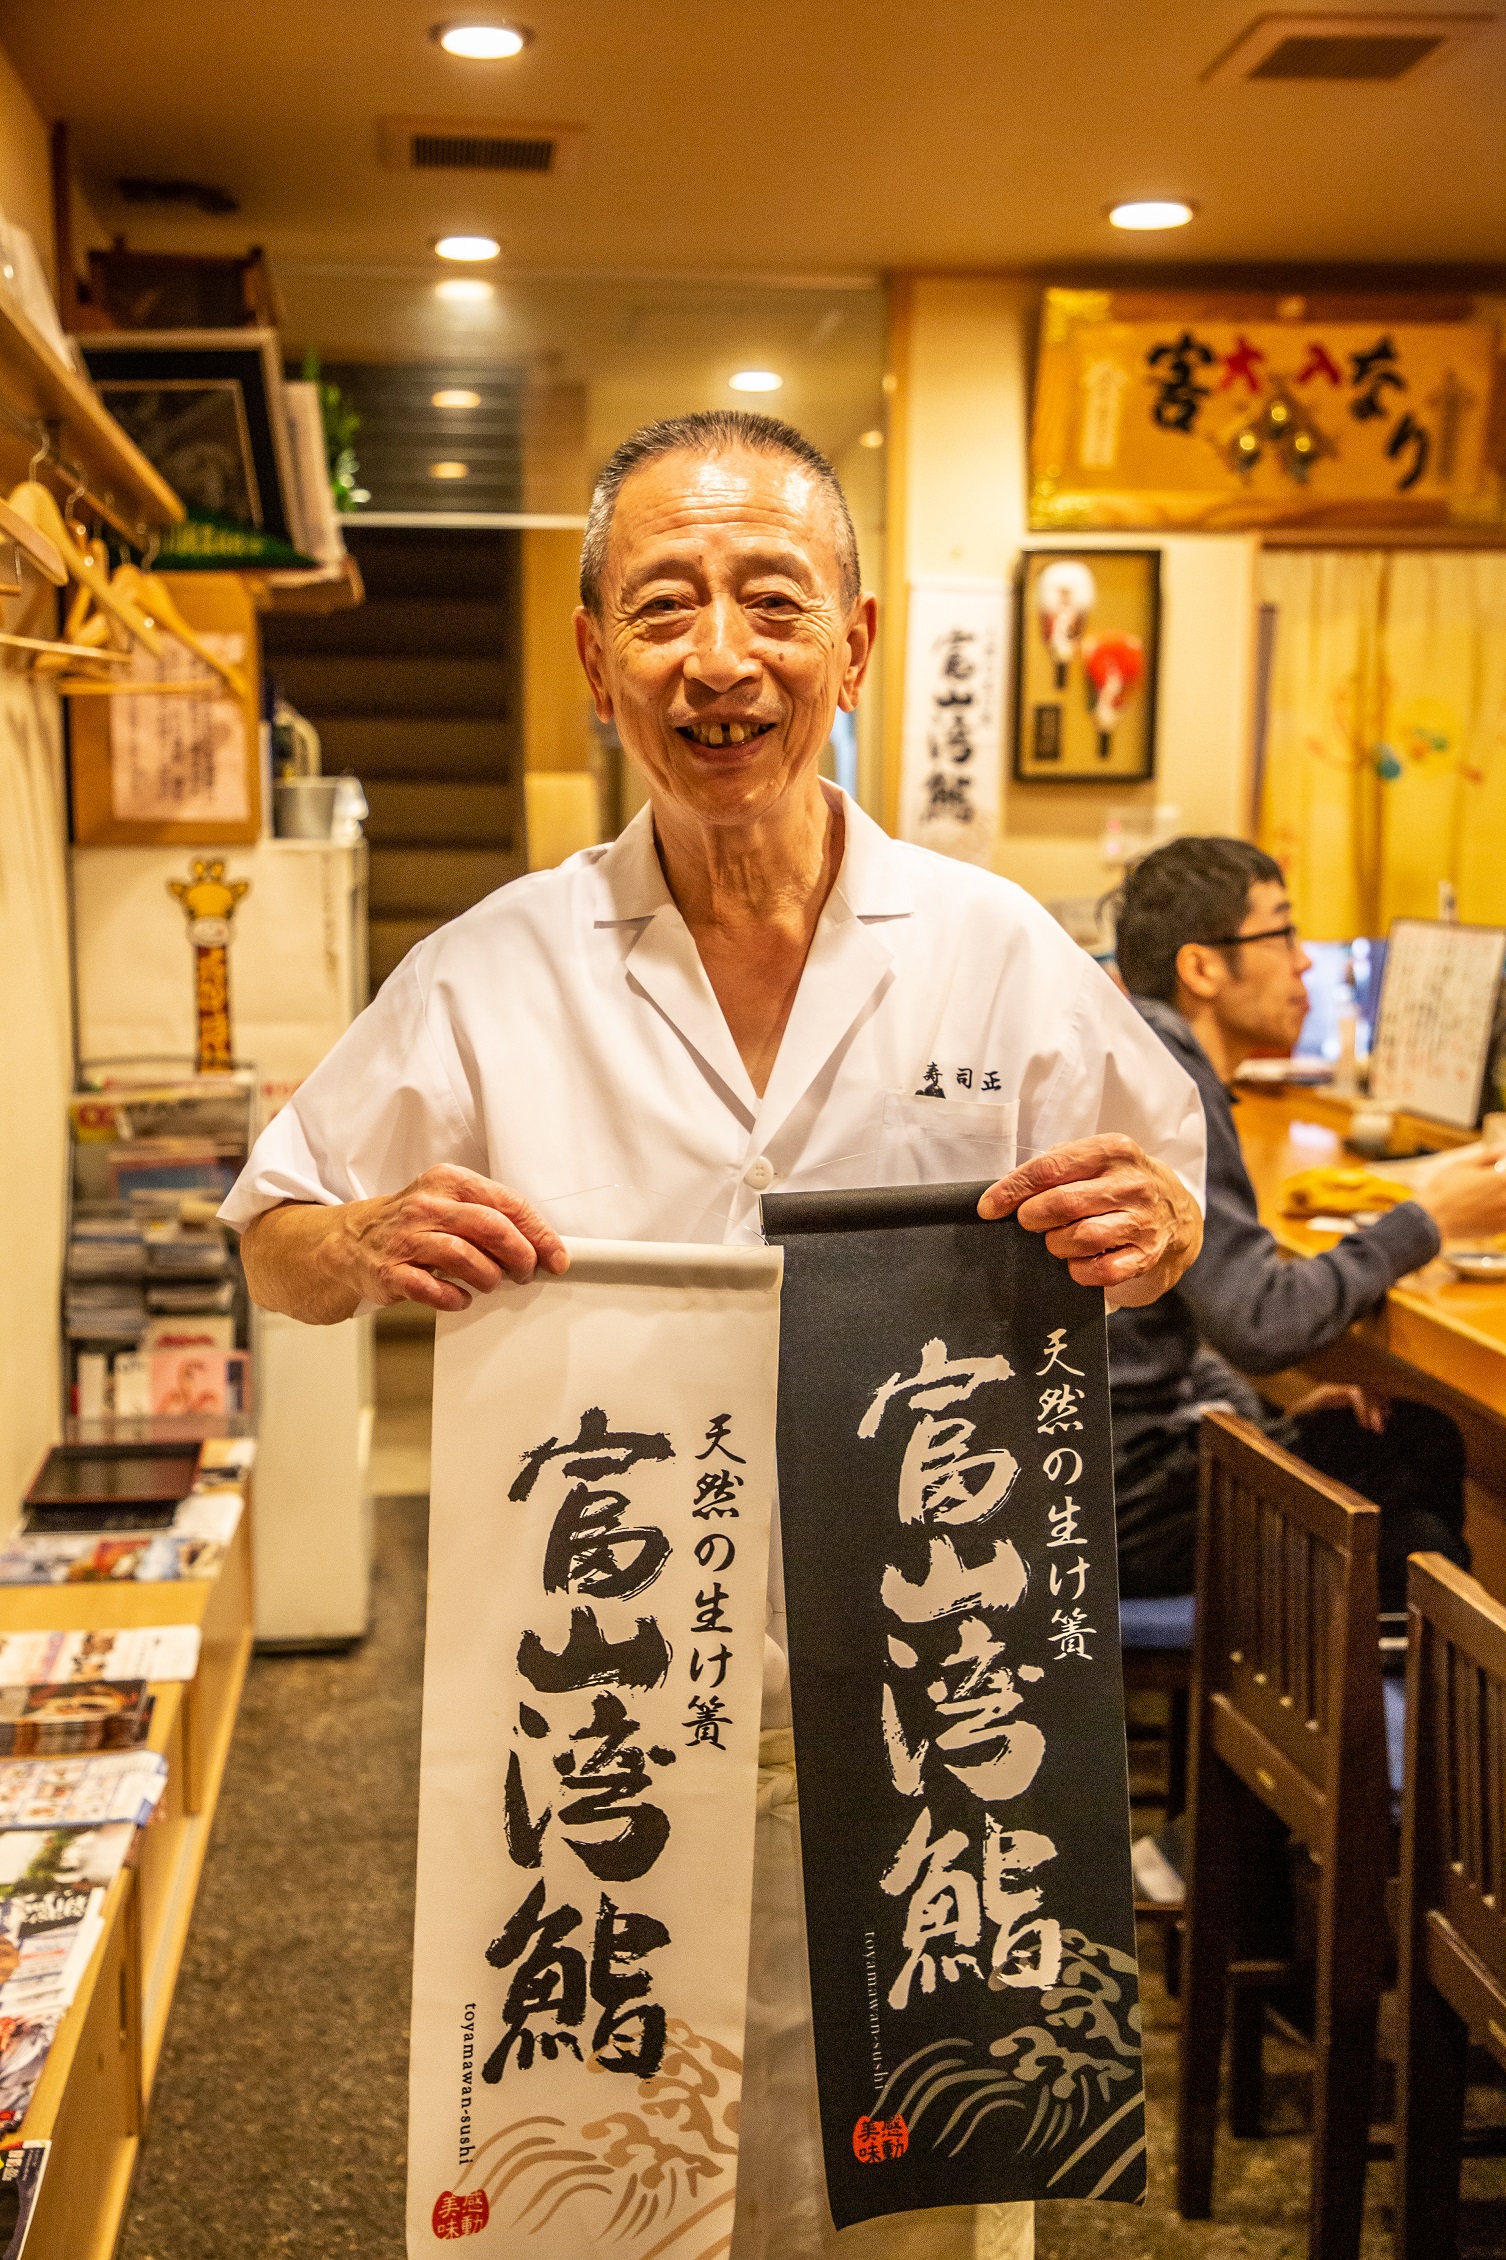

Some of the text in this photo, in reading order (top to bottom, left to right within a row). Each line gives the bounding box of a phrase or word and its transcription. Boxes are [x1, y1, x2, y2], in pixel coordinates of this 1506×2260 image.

[922, 1061, 1002, 1092] 寿司正
[681, 1412, 747, 1751] 天然の生け簀
[1035, 1328, 1098, 1661] 天然の生け簀
[481, 1406, 676, 2084] 富山湾鮨
[856, 1336, 1063, 2011] 富山湾鮨
[458, 2002, 477, 2166] toyamawan-sushi
[862, 1931, 890, 2090] toyamawan-sushi
